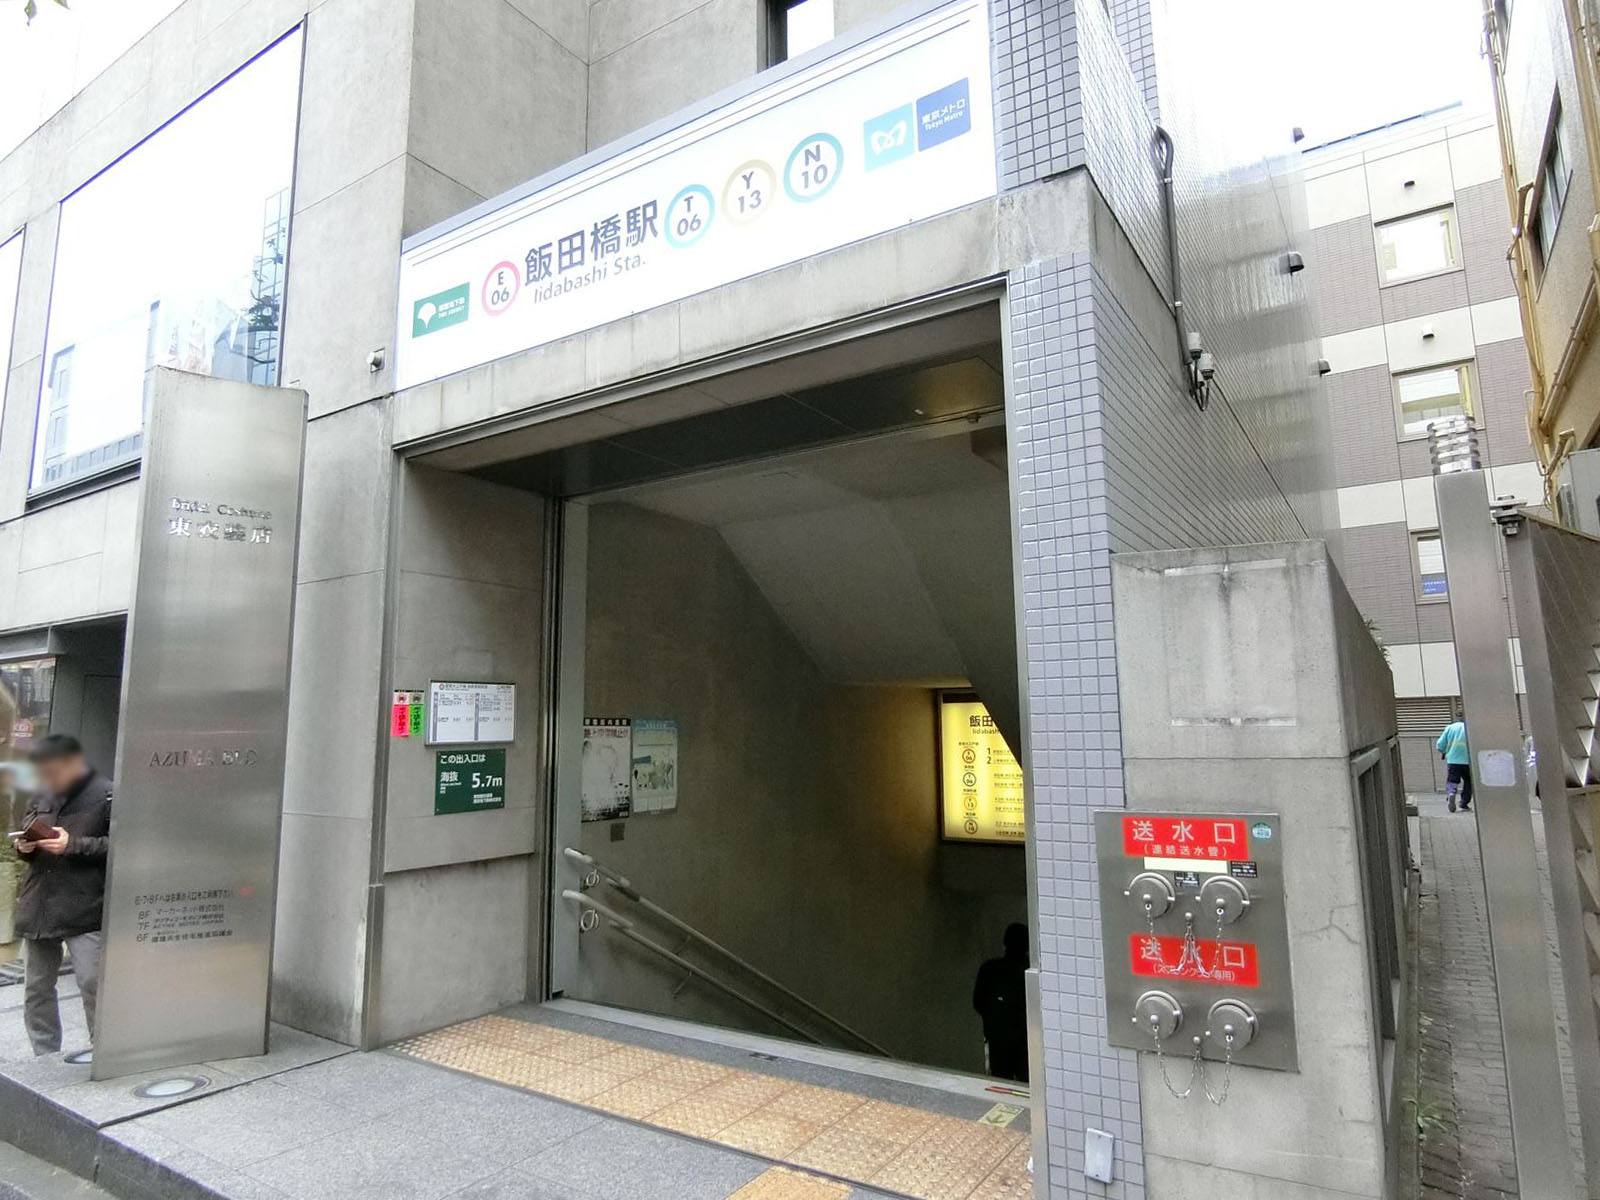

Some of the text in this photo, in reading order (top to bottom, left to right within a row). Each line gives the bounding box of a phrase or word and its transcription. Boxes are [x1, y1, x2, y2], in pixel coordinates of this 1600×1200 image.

[921, 98, 966, 126] 東京メトロ
[804, 144, 821, 166] N
[741, 171, 754, 190] Y
[801, 164, 828, 189] 10
[684, 196, 694, 213] T
[737, 190, 762, 214] 13
[677, 214, 702, 237] 06
[524, 202, 659, 287] 飯田橋駅
[498, 271, 504, 286] E
[533, 254, 646, 305] Iidabashi Sta.
[491, 286, 510, 306] 06
[440, 753, 487, 765] この出入口は
[986, 756, 991, 765] 2
[471, 772, 503, 789] 5.7m
[1132, 820, 1236, 844] 送水口
[138, 910, 151, 920] 8F
[137, 921, 150, 931] 7F
[136, 933, 149, 943] 6F
